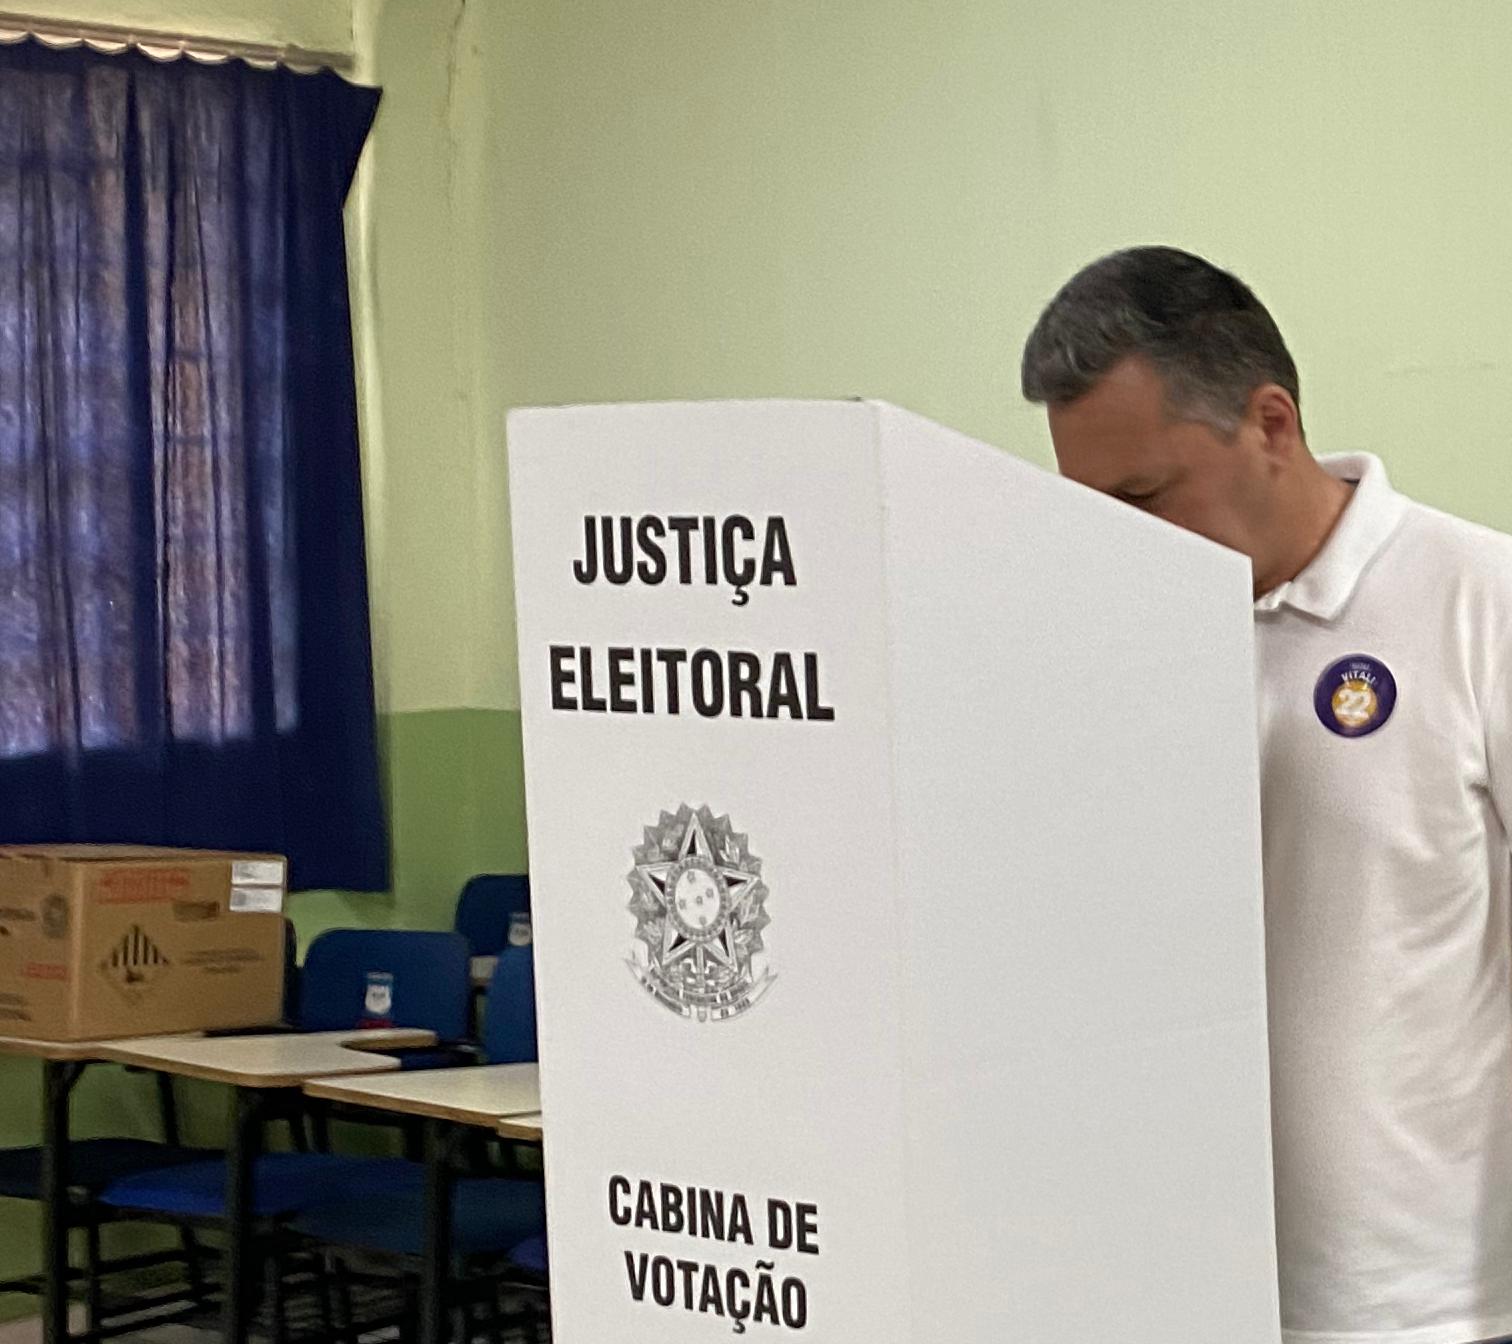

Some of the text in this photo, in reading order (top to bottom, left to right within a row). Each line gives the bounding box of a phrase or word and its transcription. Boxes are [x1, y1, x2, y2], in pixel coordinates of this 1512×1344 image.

[573, 514, 797, 606] JUSTIÇA
[549, 645, 835, 721] ELEITORAL
[1335, 689, 1371, 719] 22
[608, 1174, 819, 1255] CABINA DE
[624, 1250, 807, 1334] VOTAÇÃO
